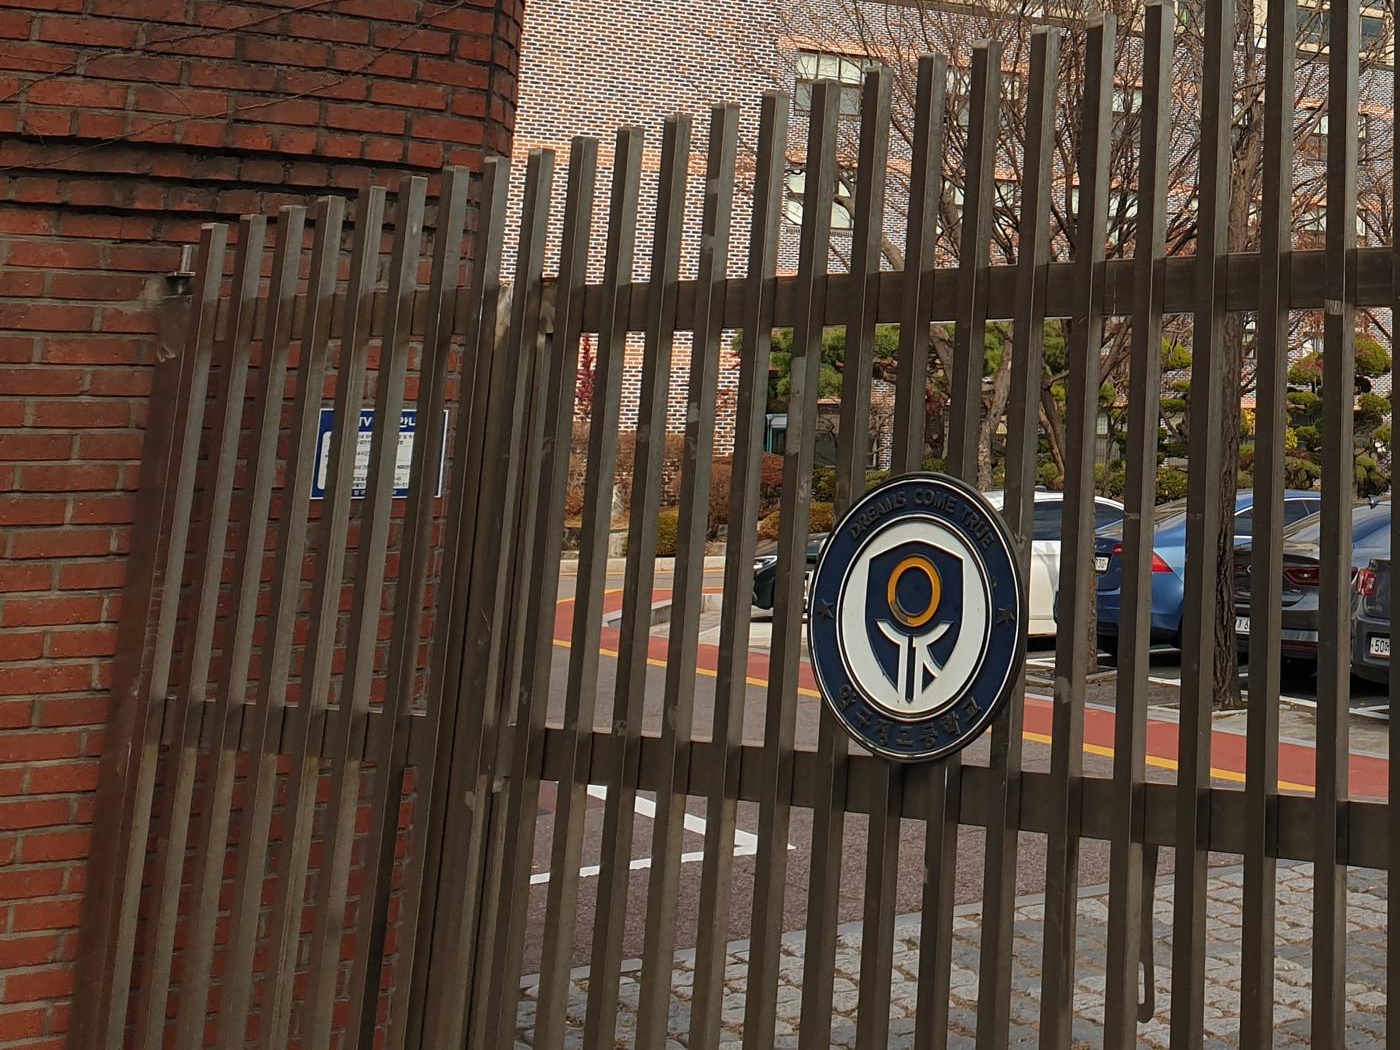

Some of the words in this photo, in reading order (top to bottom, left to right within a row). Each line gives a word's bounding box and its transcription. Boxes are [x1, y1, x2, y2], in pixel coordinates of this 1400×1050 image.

[850, 491, 906, 539] DREAMS
[913, 488, 957, 513] COME
[960, 504, 995, 549] TRUE
[837, 683, 982, 749] 압구정고등학교
